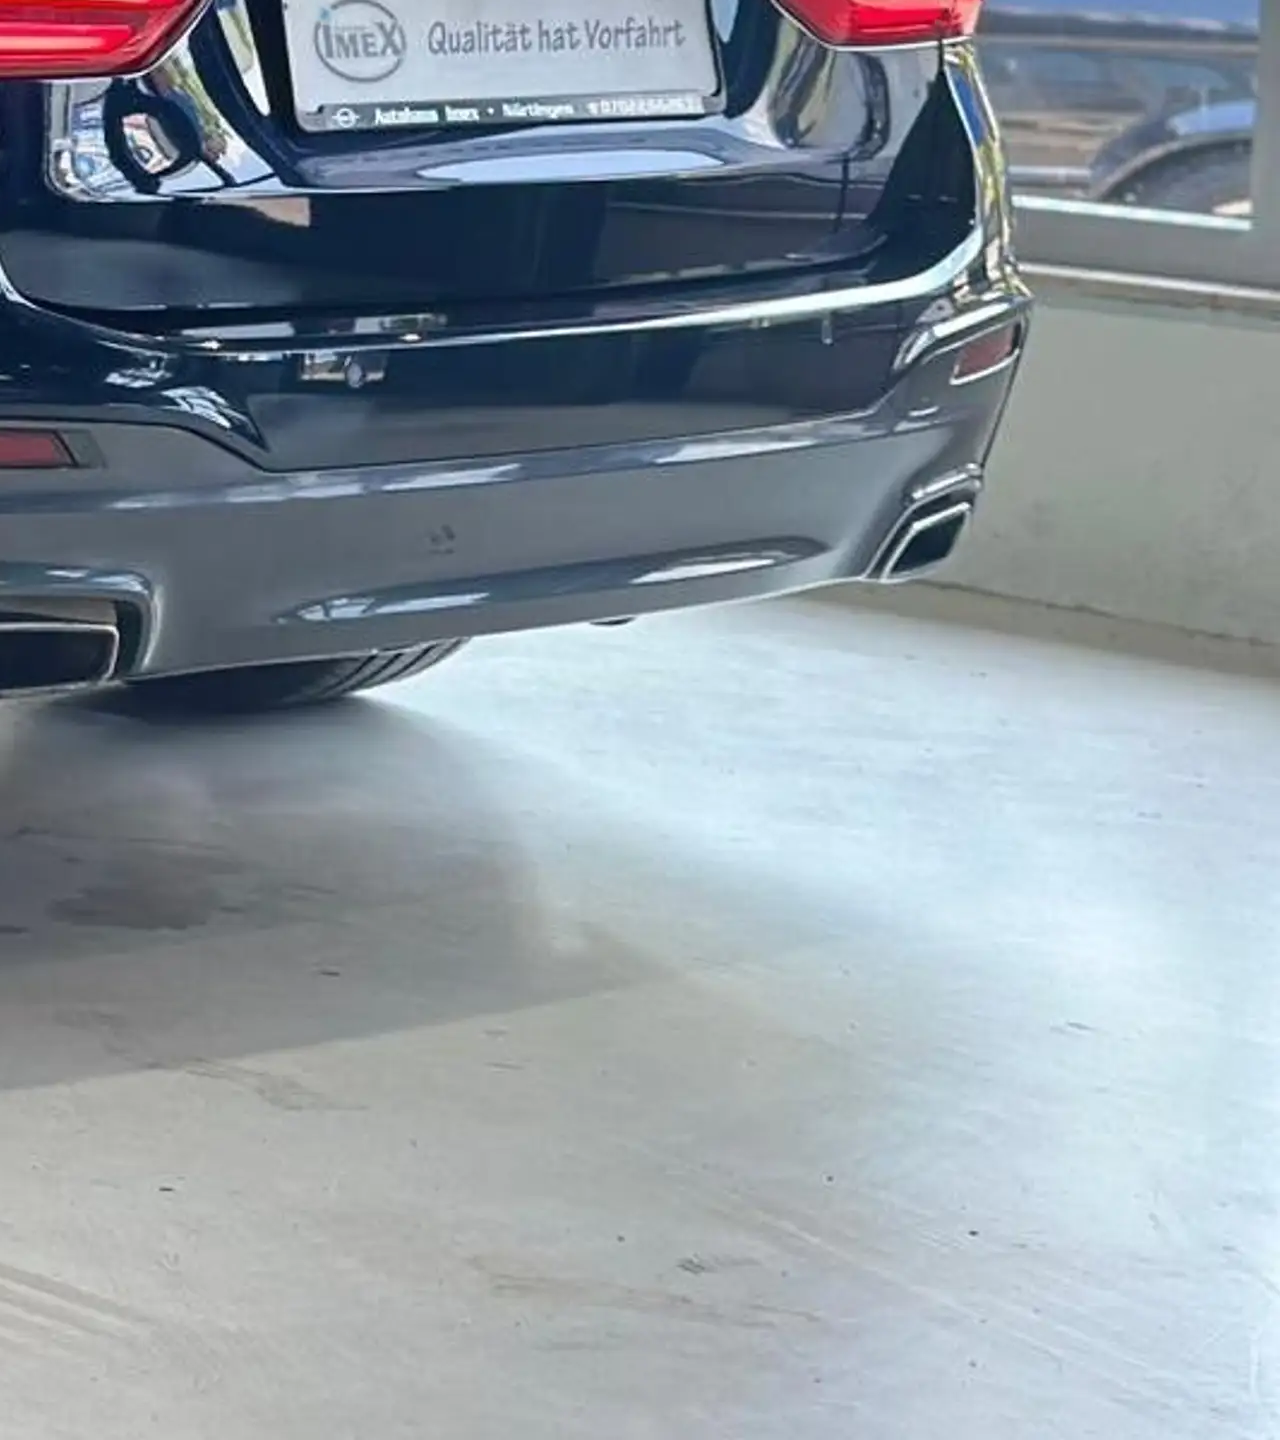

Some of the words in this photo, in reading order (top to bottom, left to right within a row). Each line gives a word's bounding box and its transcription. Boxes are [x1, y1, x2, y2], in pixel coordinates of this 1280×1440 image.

[427, 21, 531, 57] Qualität
[538, 18, 581, 53] hat
[583, 16, 687, 50] Vorfahrt
